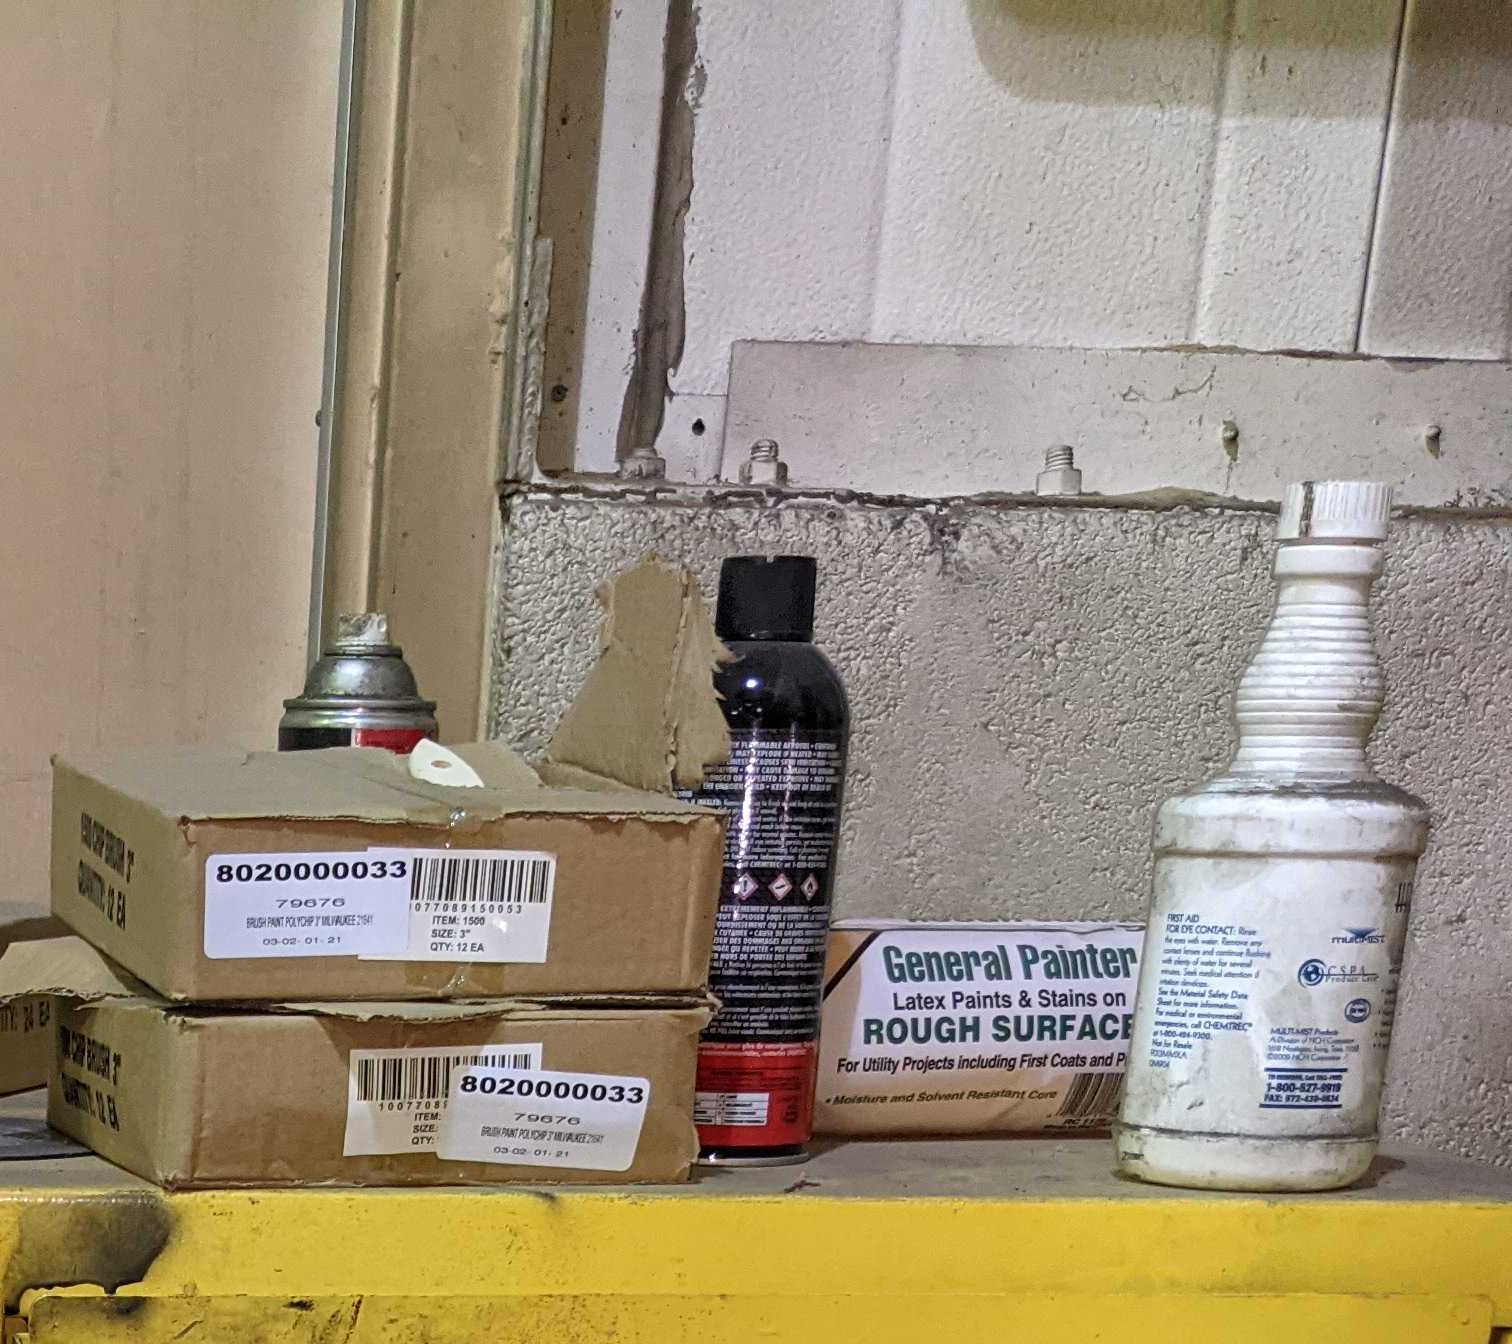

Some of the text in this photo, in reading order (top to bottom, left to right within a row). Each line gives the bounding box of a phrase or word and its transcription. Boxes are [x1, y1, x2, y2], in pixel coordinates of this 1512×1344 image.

[216, 860, 407, 883] 8020000033
[275, 897, 346, 909] 79676
[432, 915, 486, 926] ITEM: 1500
[1167, 913, 1200, 923] FIRST AID
[431, 928, 457, 938] SIZE:
[1166, 923, 1180, 934] FOR
[1194, 925, 1236, 936] CONTACT:
[1238, 926, 1257, 936] Rinse
[430, 942, 485, 952] QTY: 12 EA
[883, 943, 1138, 984] General Painter
[893, 989, 1127, 1011] Latex Paints & Stains on
[1180, 989, 1206, 998] Material
[1207, 989, 1229, 1000] Safety
[863, 1015, 981, 1045] ROUGH
[837, 1052, 1113, 1075] For Utility Projects including First Coats and
[460, 1075, 644, 1104] 8020000033
[890, 1092, 915, 1103] and
[917, 1090, 966, 1102] Solvent
[968, 1089, 1025, 1101] Resistant
[1027, 1089, 1058, 1100] Core
[414, 1112, 441, 1121] ITEM:
[514, 1112, 581, 1126] 79676
